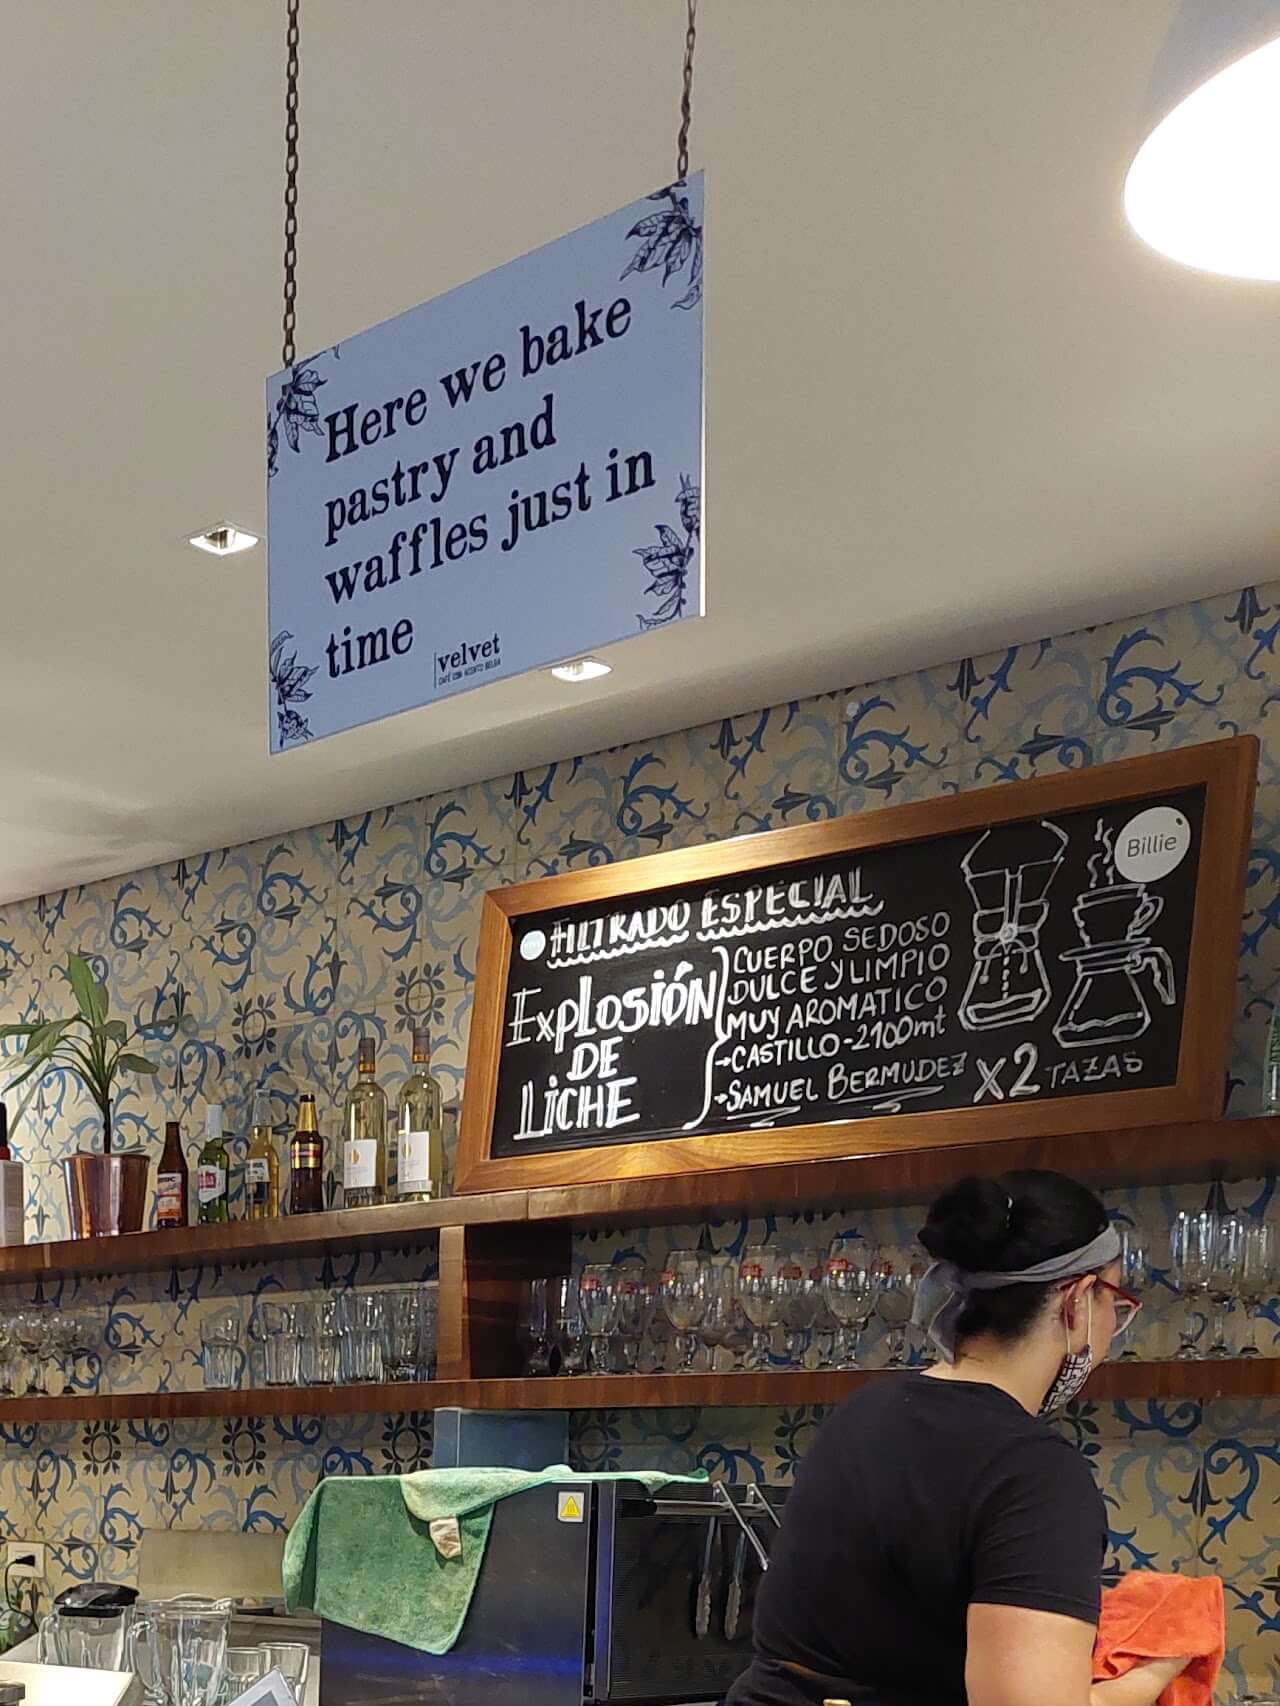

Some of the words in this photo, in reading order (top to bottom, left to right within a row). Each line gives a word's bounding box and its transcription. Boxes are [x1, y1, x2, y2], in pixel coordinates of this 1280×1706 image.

[324, 388, 428, 464] Here
[440, 352, 505, 409] we
[520, 297, 632, 378] bake
[323, 447, 460, 546] pastry
[472, 393, 558, 475] and
[324, 508, 488, 605] waffles
[501, 462, 592, 552] just
[606, 446, 656, 503] in
[326, 618, 414, 679] time
[437, 633, 501, 672] velvet
[1126, 834, 1178, 858] Billie
[702, 867, 874, 929] ESPECIAL
[728, 967, 817, 1005] DULCE
[849, 943, 951, 984] LIMPIO
[733, 934, 834, 976] CUERPO
[843, 911, 951, 952] SEDOSO
[786, 975, 948, 1035] AROMATICO
[566, 1036, 624, 1082] DE
[726, 1073, 818, 1112] SAMUEL
[827, 1051, 968, 1101] BERMUDEZ
[1045, 1052, 1144, 1090] TAZAS
